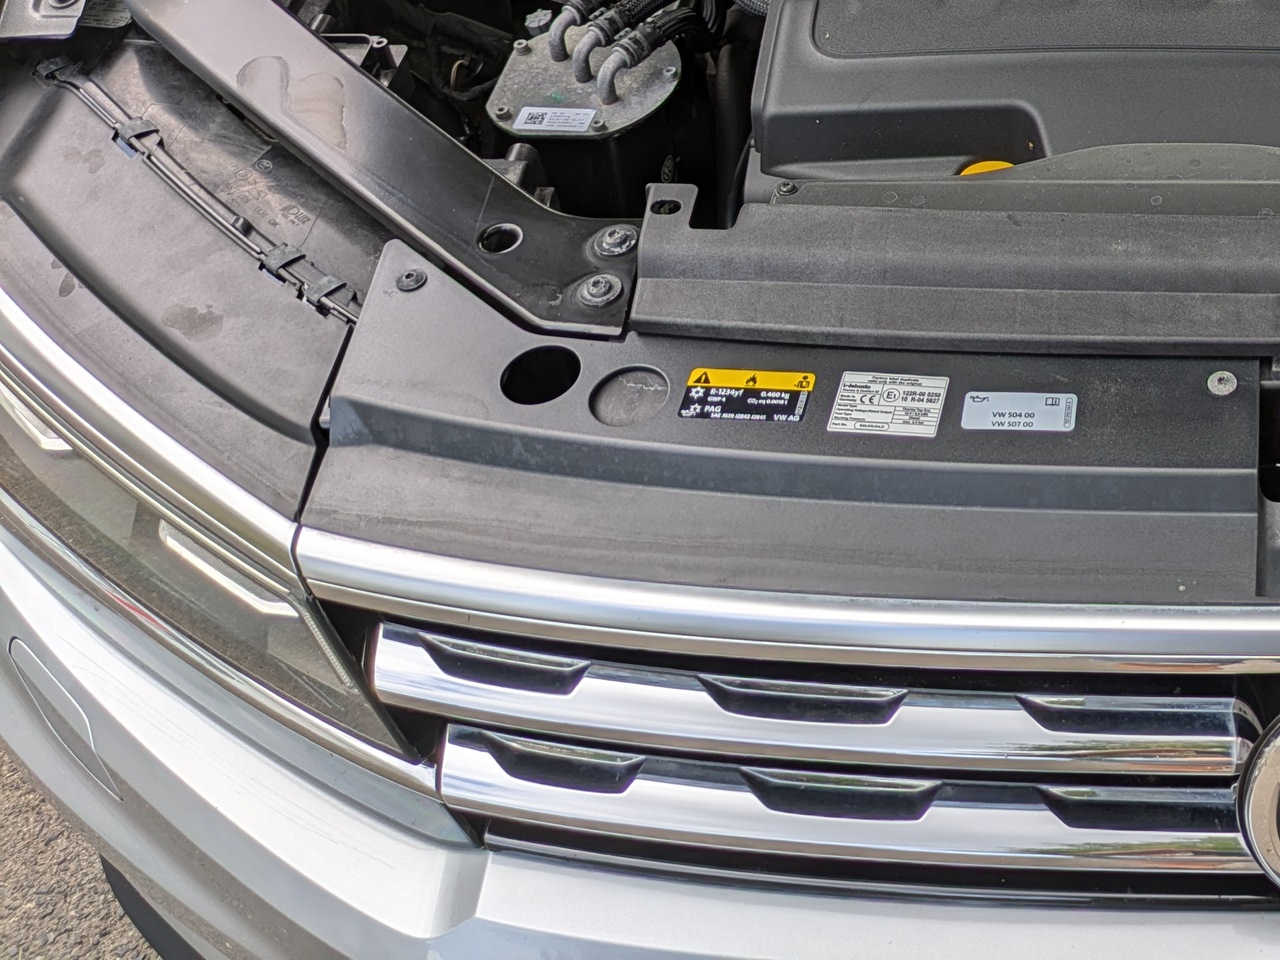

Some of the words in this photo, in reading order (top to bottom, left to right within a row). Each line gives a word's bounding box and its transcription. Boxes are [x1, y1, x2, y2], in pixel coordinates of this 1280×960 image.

[709, 387, 744, 397] R-1234yf
[704, 405, 722, 413] PAG
[788, 414, 800, 422] AG
